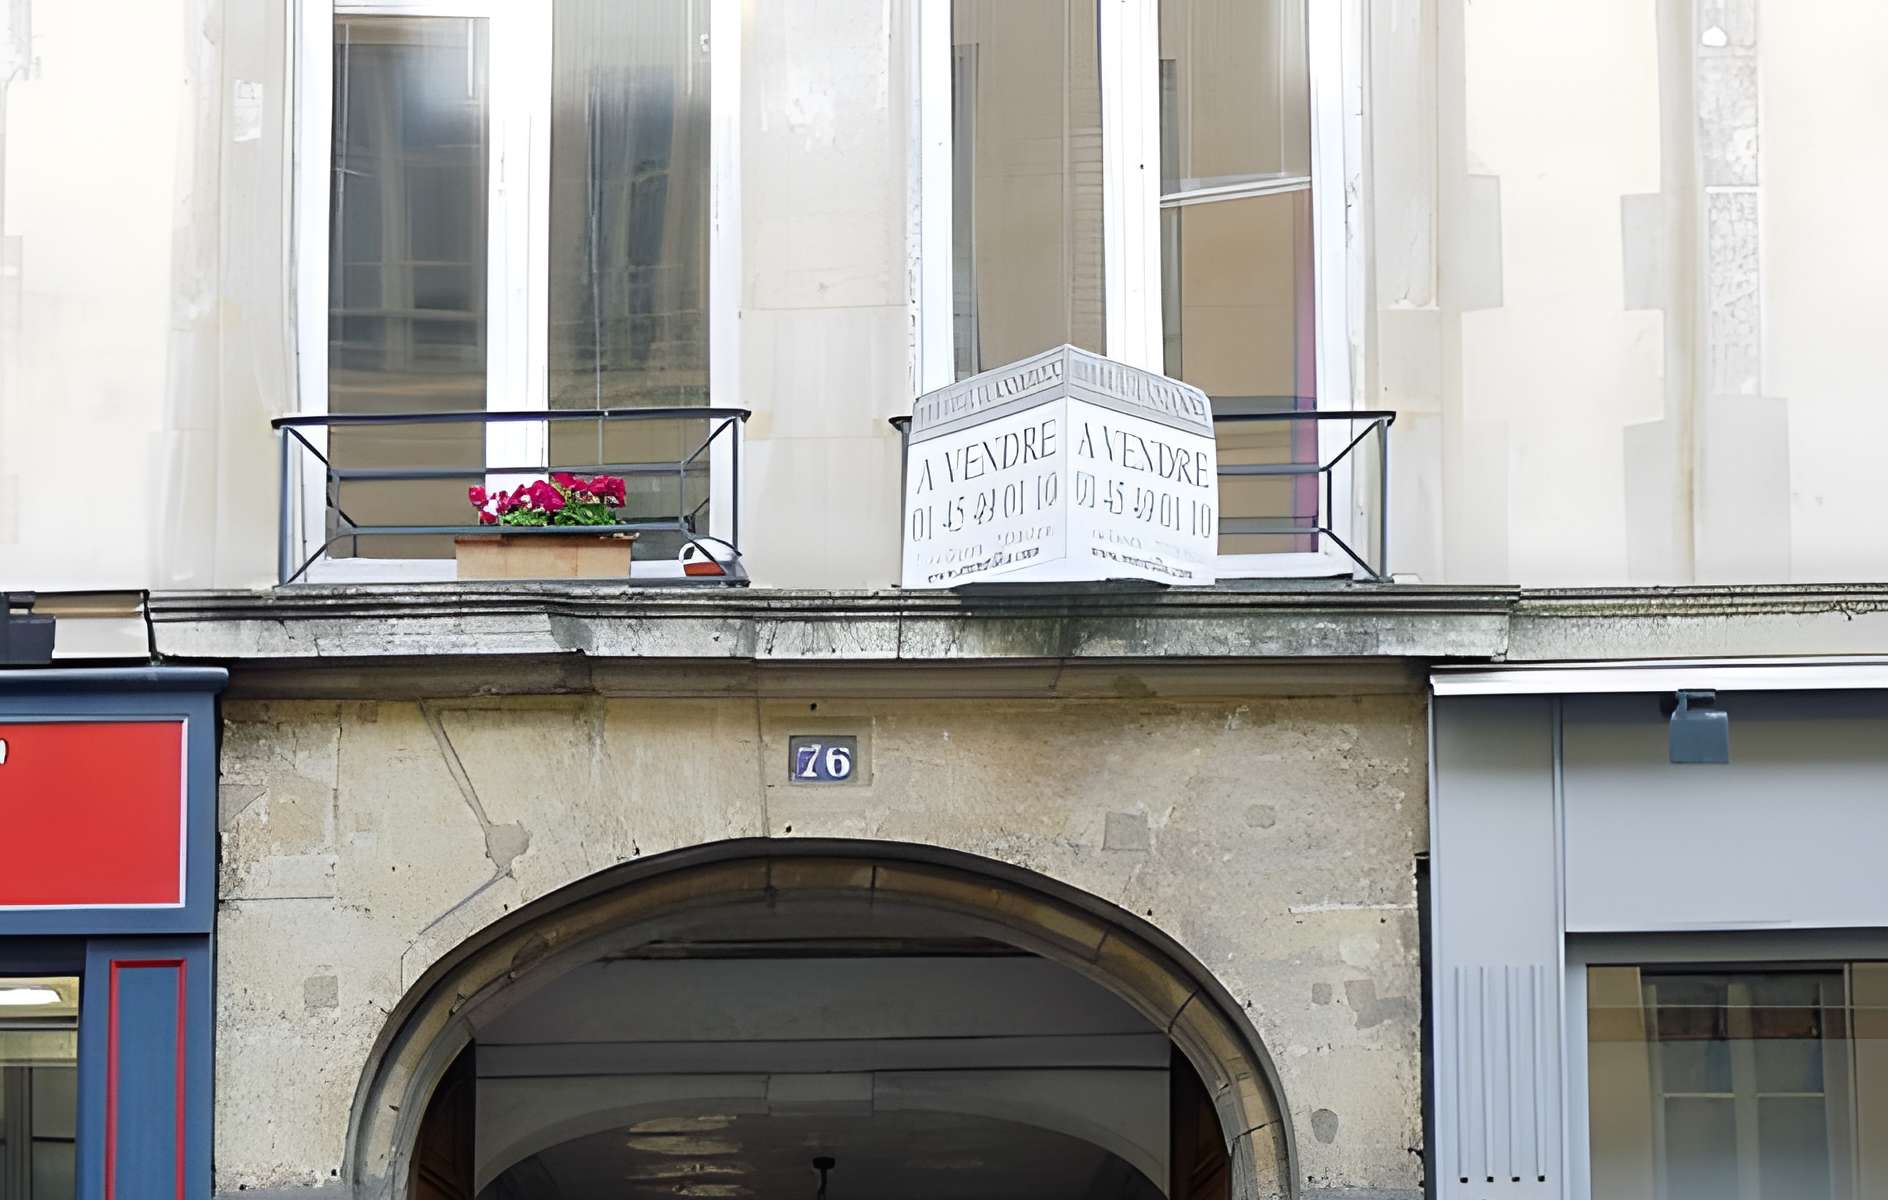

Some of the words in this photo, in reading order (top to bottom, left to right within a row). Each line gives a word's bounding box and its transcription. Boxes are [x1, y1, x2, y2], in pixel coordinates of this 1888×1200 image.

[944, 419, 1057, 483] VENDRE
[1103, 425, 1209, 489] VENDRE
[797, 743, 851, 778] 76
